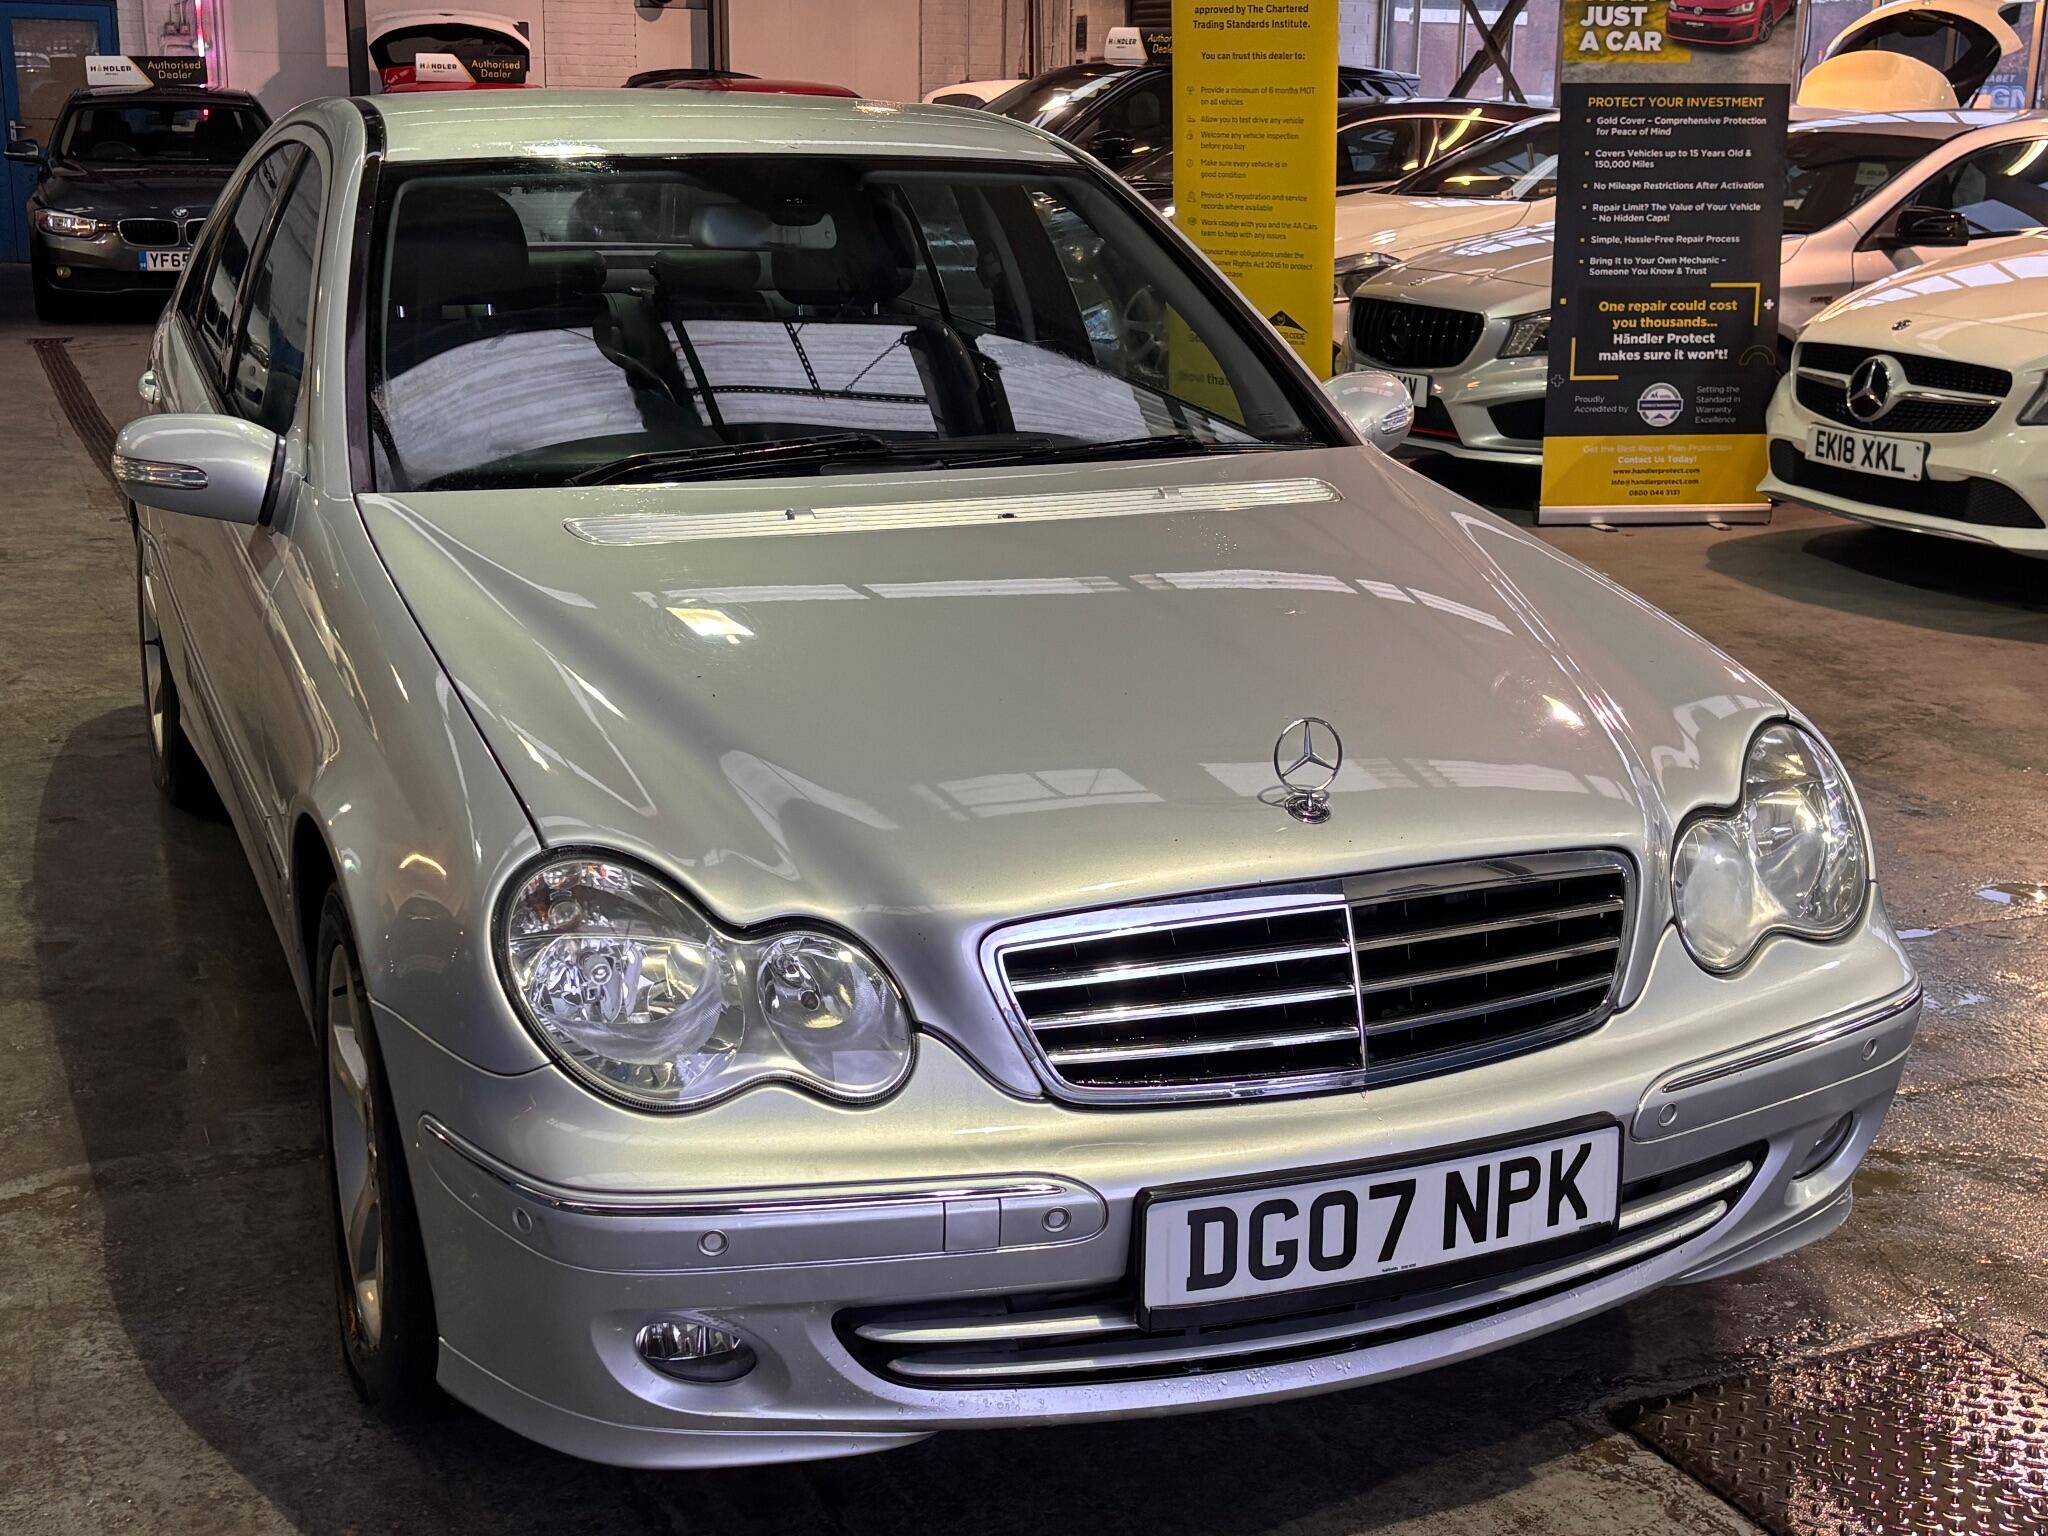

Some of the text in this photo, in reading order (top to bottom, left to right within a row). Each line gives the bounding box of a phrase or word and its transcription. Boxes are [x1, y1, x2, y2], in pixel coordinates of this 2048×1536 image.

[1194, 4, 1309, 15] approved by The Chartered
[1580, 6, 1648, 26] JUST
[1193, 20, 1310, 30] Trading Standards Institute.
[1148, 34, 1172, 42] Author
[1578, 31, 1662, 51] A CAR
[1153, 44, 1172, 54] Deale
[1202, 52, 1215, 60] You
[148, 61, 201, 70] Authorised
[472, 60, 520, 70] Authorised
[158, 71, 192, 79] Dealer
[481, 69, 512, 78] Dealer
[1988, 74, 2016, 82] ABET
[1588, 96, 1765, 108] PROTECT YOUR INVESTMENT
[1596, 116, 1766, 126] Gold Cover Comprehensive Protection
[1596, 127, 1671, 136] for Peace of Mind
[1627, 149, 1663, 158] Vehicles
[1664, 151, 1676, 159] up
[1690, 150, 1699, 158] 15
[1701, 150, 1726, 158] Years
[1727, 149, 1744, 157] Old
[1594, 160, 1654, 169] 150,000 Miles
[1608, 182, 1642, 191] Mileage
[1644, 181, 1694, 190] Restrictions
[1696, 182, 1718, 190] After
[1721, 181, 1764, 189] Activation
[1235, 193, 1270, 201] registration
[1592, 203, 1761, 213] Repair Limit? The Value of Your Vehicle
[1218, 220, 1239, 228] closely
[1599, 214, 1670, 224] No Hidden Caps!
[1590, 235, 1740, 245] Simple, Hassle-Free Repair Process
[1590, 257, 1613, 266] Bring
[1679, 256, 1720, 265] Mechanic
[1589, 267, 1707, 276] Someone You Know & Trust
[1599, 300, 1738, 314] One repair could cost
[1612, 316, 1718, 330] you thousands...
[1613, 333, 1715, 344] Händler Protect
[1599, 350, 1640, 361] makes
[1644, 352, 1671, 360] sure
[1674, 349, 1685, 360] it
[1696, 386, 1724, 395] Setting
[1574, 396, 1604, 404] Proudly
[1574, 404, 1628, 414] Accredited by
[1696, 406, 1732, 415] Warranty
[1695, 416, 1736, 424] Excellence
[1815, 430, 1905, 473] EK18 XKL
[1668, 456, 1697, 464] Today!
[1186, 1142, 1592, 1292] DG07 NPK
